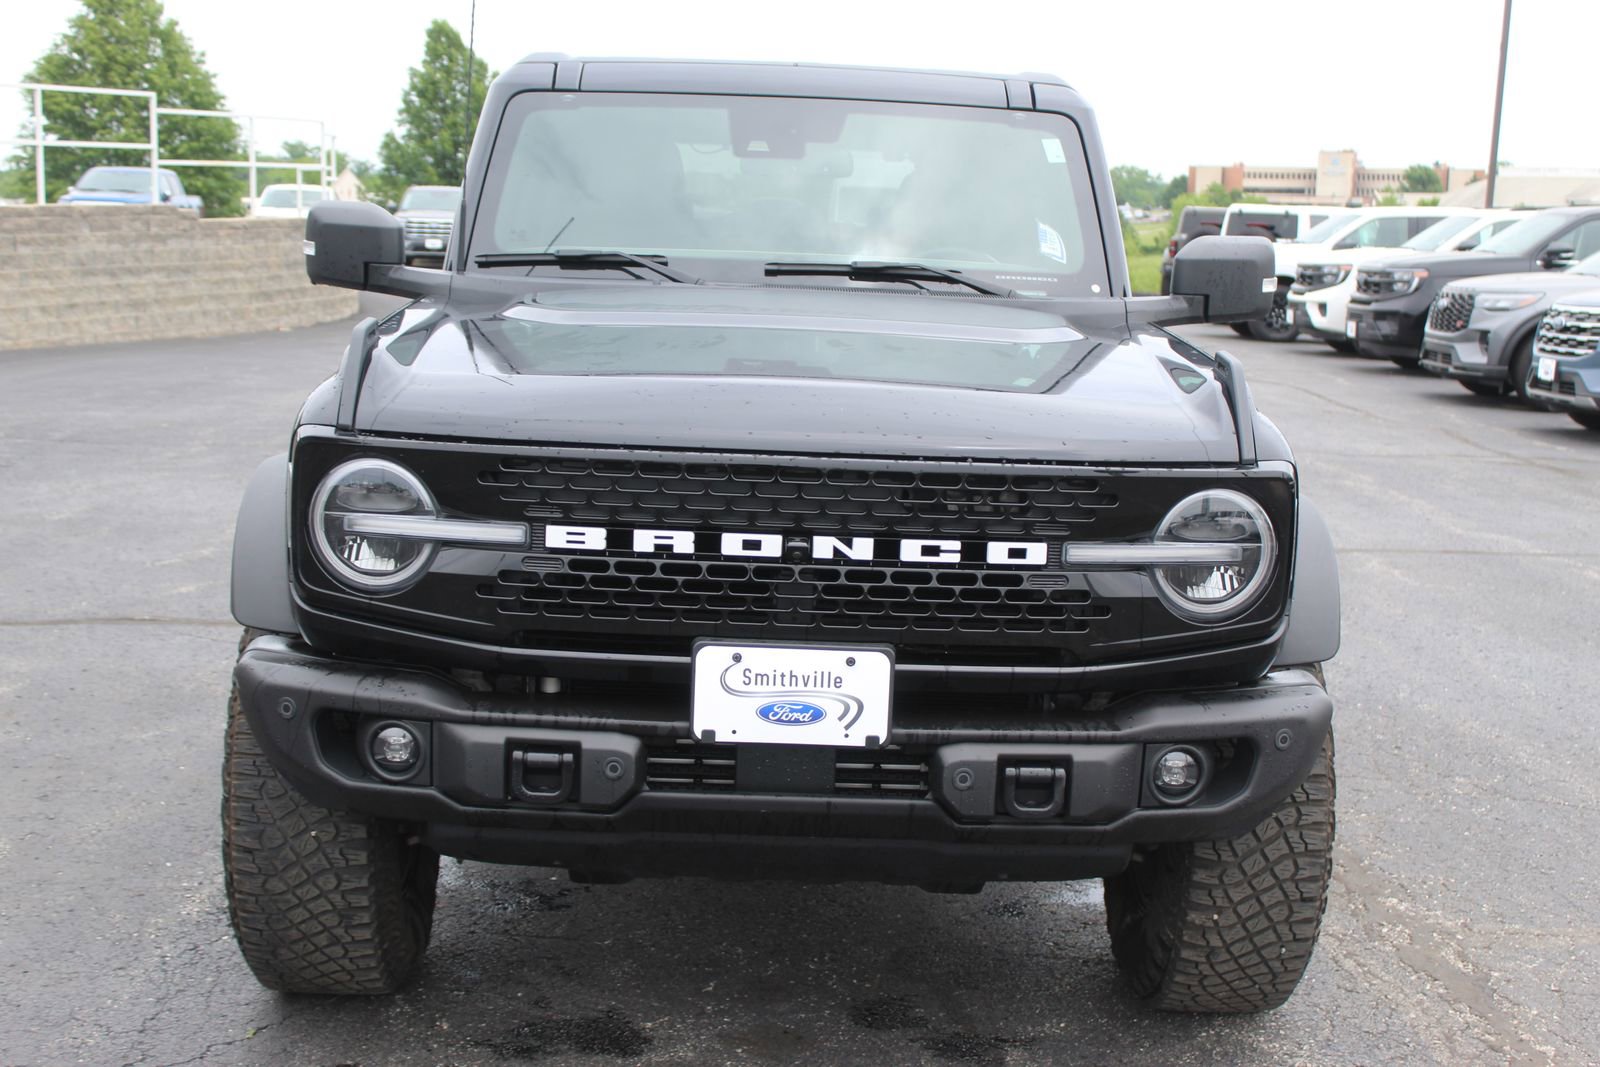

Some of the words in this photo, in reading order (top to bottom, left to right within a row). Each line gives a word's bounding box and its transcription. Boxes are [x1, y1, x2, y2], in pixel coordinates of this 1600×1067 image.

[545, 525, 1048, 565] BRONCO
[742, 668, 843, 689] Smithville
[768, 703, 815, 723] Ford
